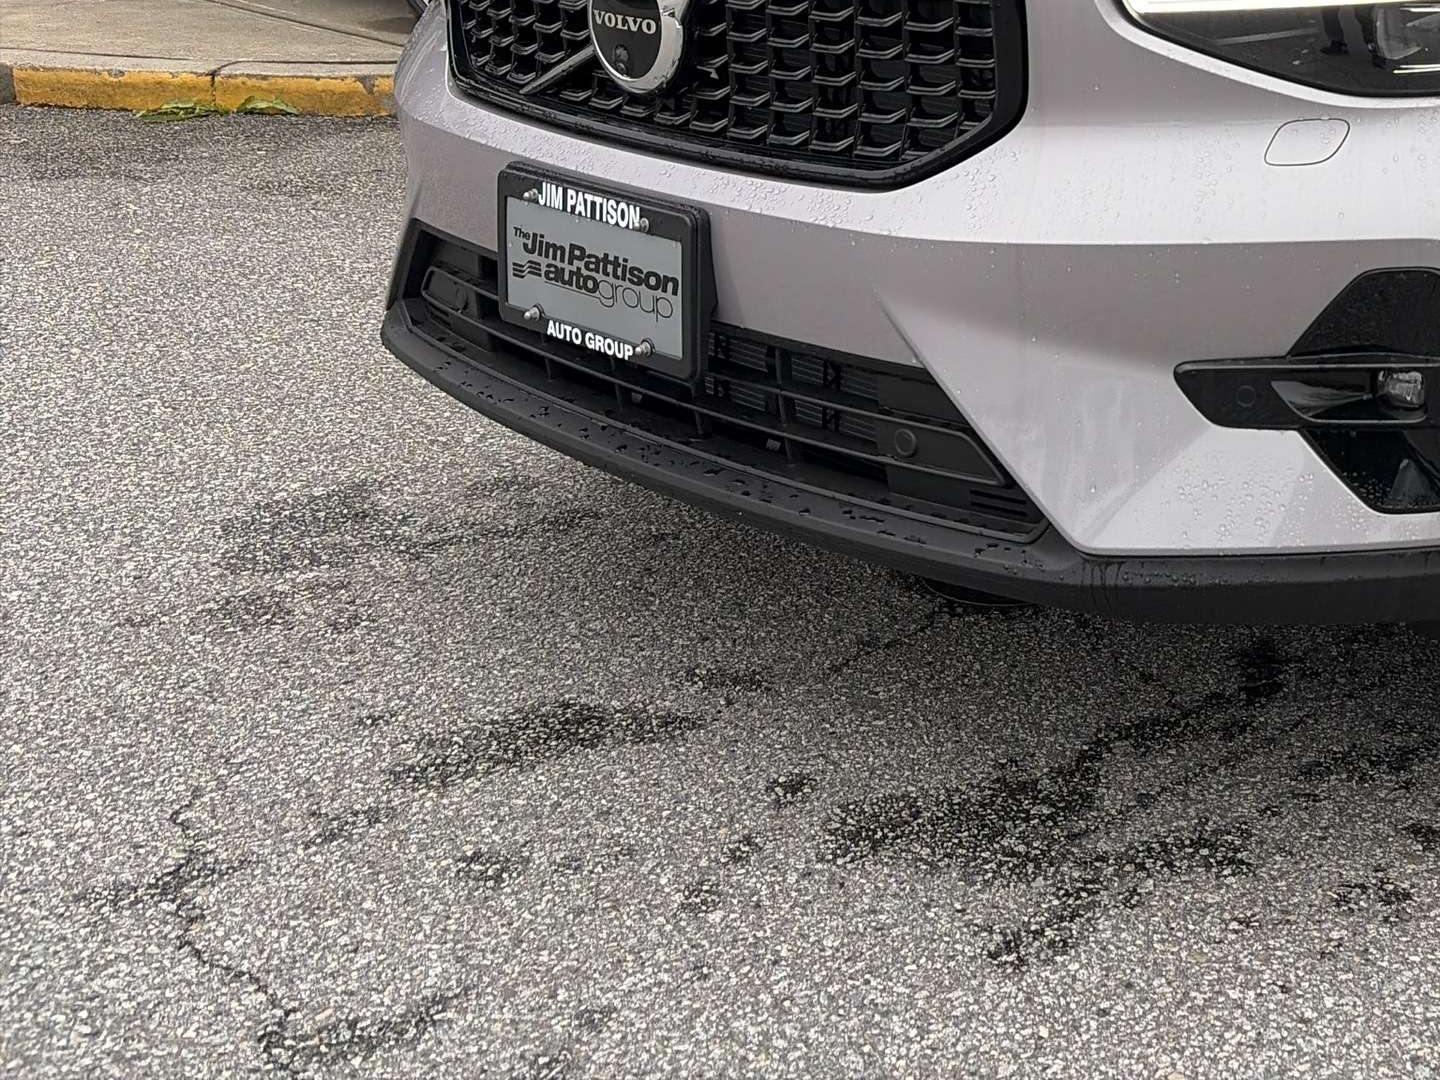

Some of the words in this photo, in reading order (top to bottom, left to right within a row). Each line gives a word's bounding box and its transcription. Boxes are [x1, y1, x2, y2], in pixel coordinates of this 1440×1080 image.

[592, 8, 657, 35] VOLVO
[538, 181, 563, 211] JIM
[566, 188, 641, 230] PATTISON
[513, 226, 531, 241] The
[546, 320, 582, 345] AUTO
[584, 332, 634, 361] GROUP
